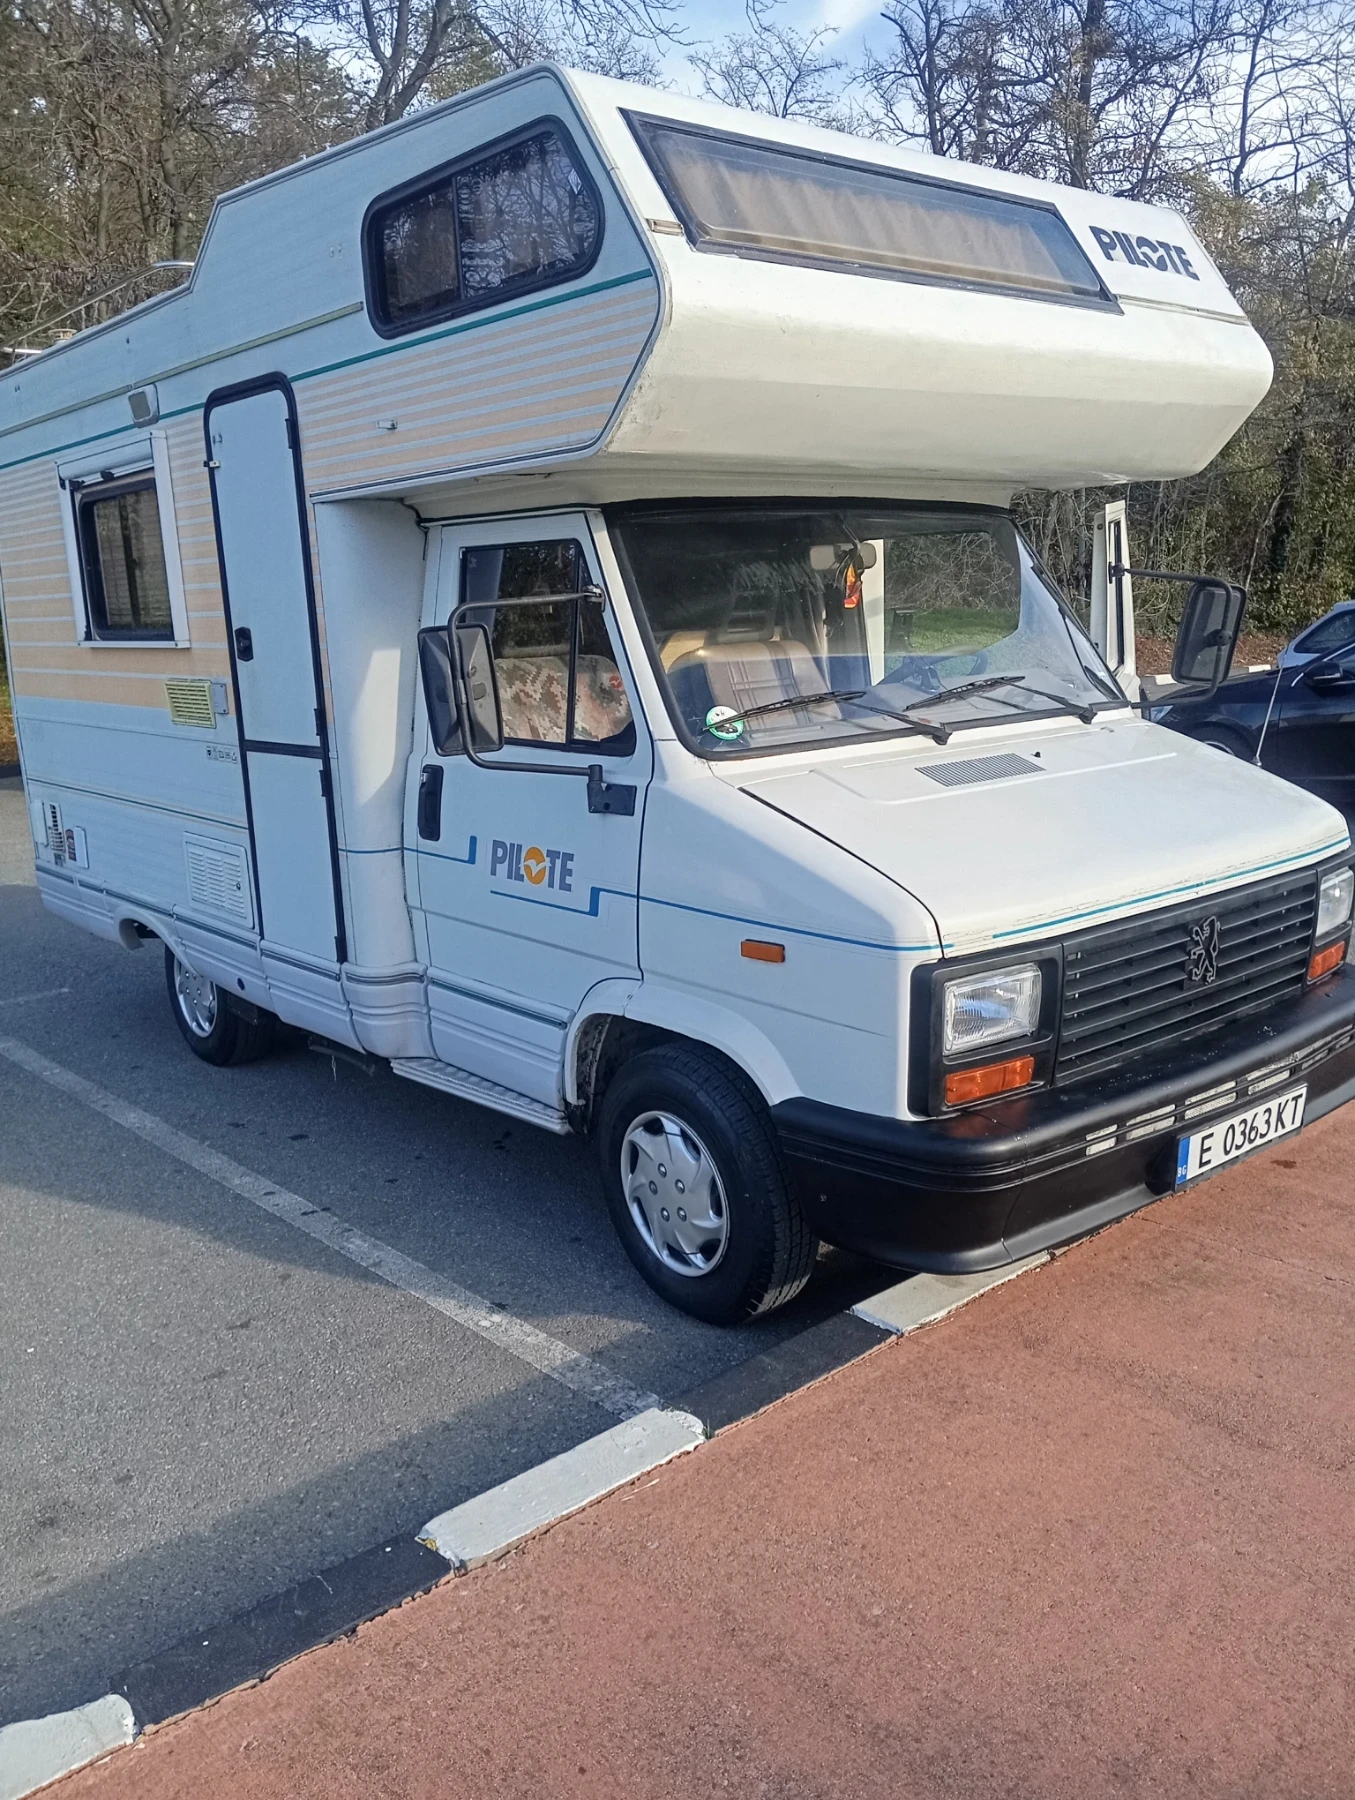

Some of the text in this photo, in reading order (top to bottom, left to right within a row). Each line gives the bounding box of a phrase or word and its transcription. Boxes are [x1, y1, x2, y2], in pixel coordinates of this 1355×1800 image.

[1089, 225, 1200, 281] PILOTE
[490, 839, 575, 892] PILOTE
[1198, 1132, 1214, 1169] E
